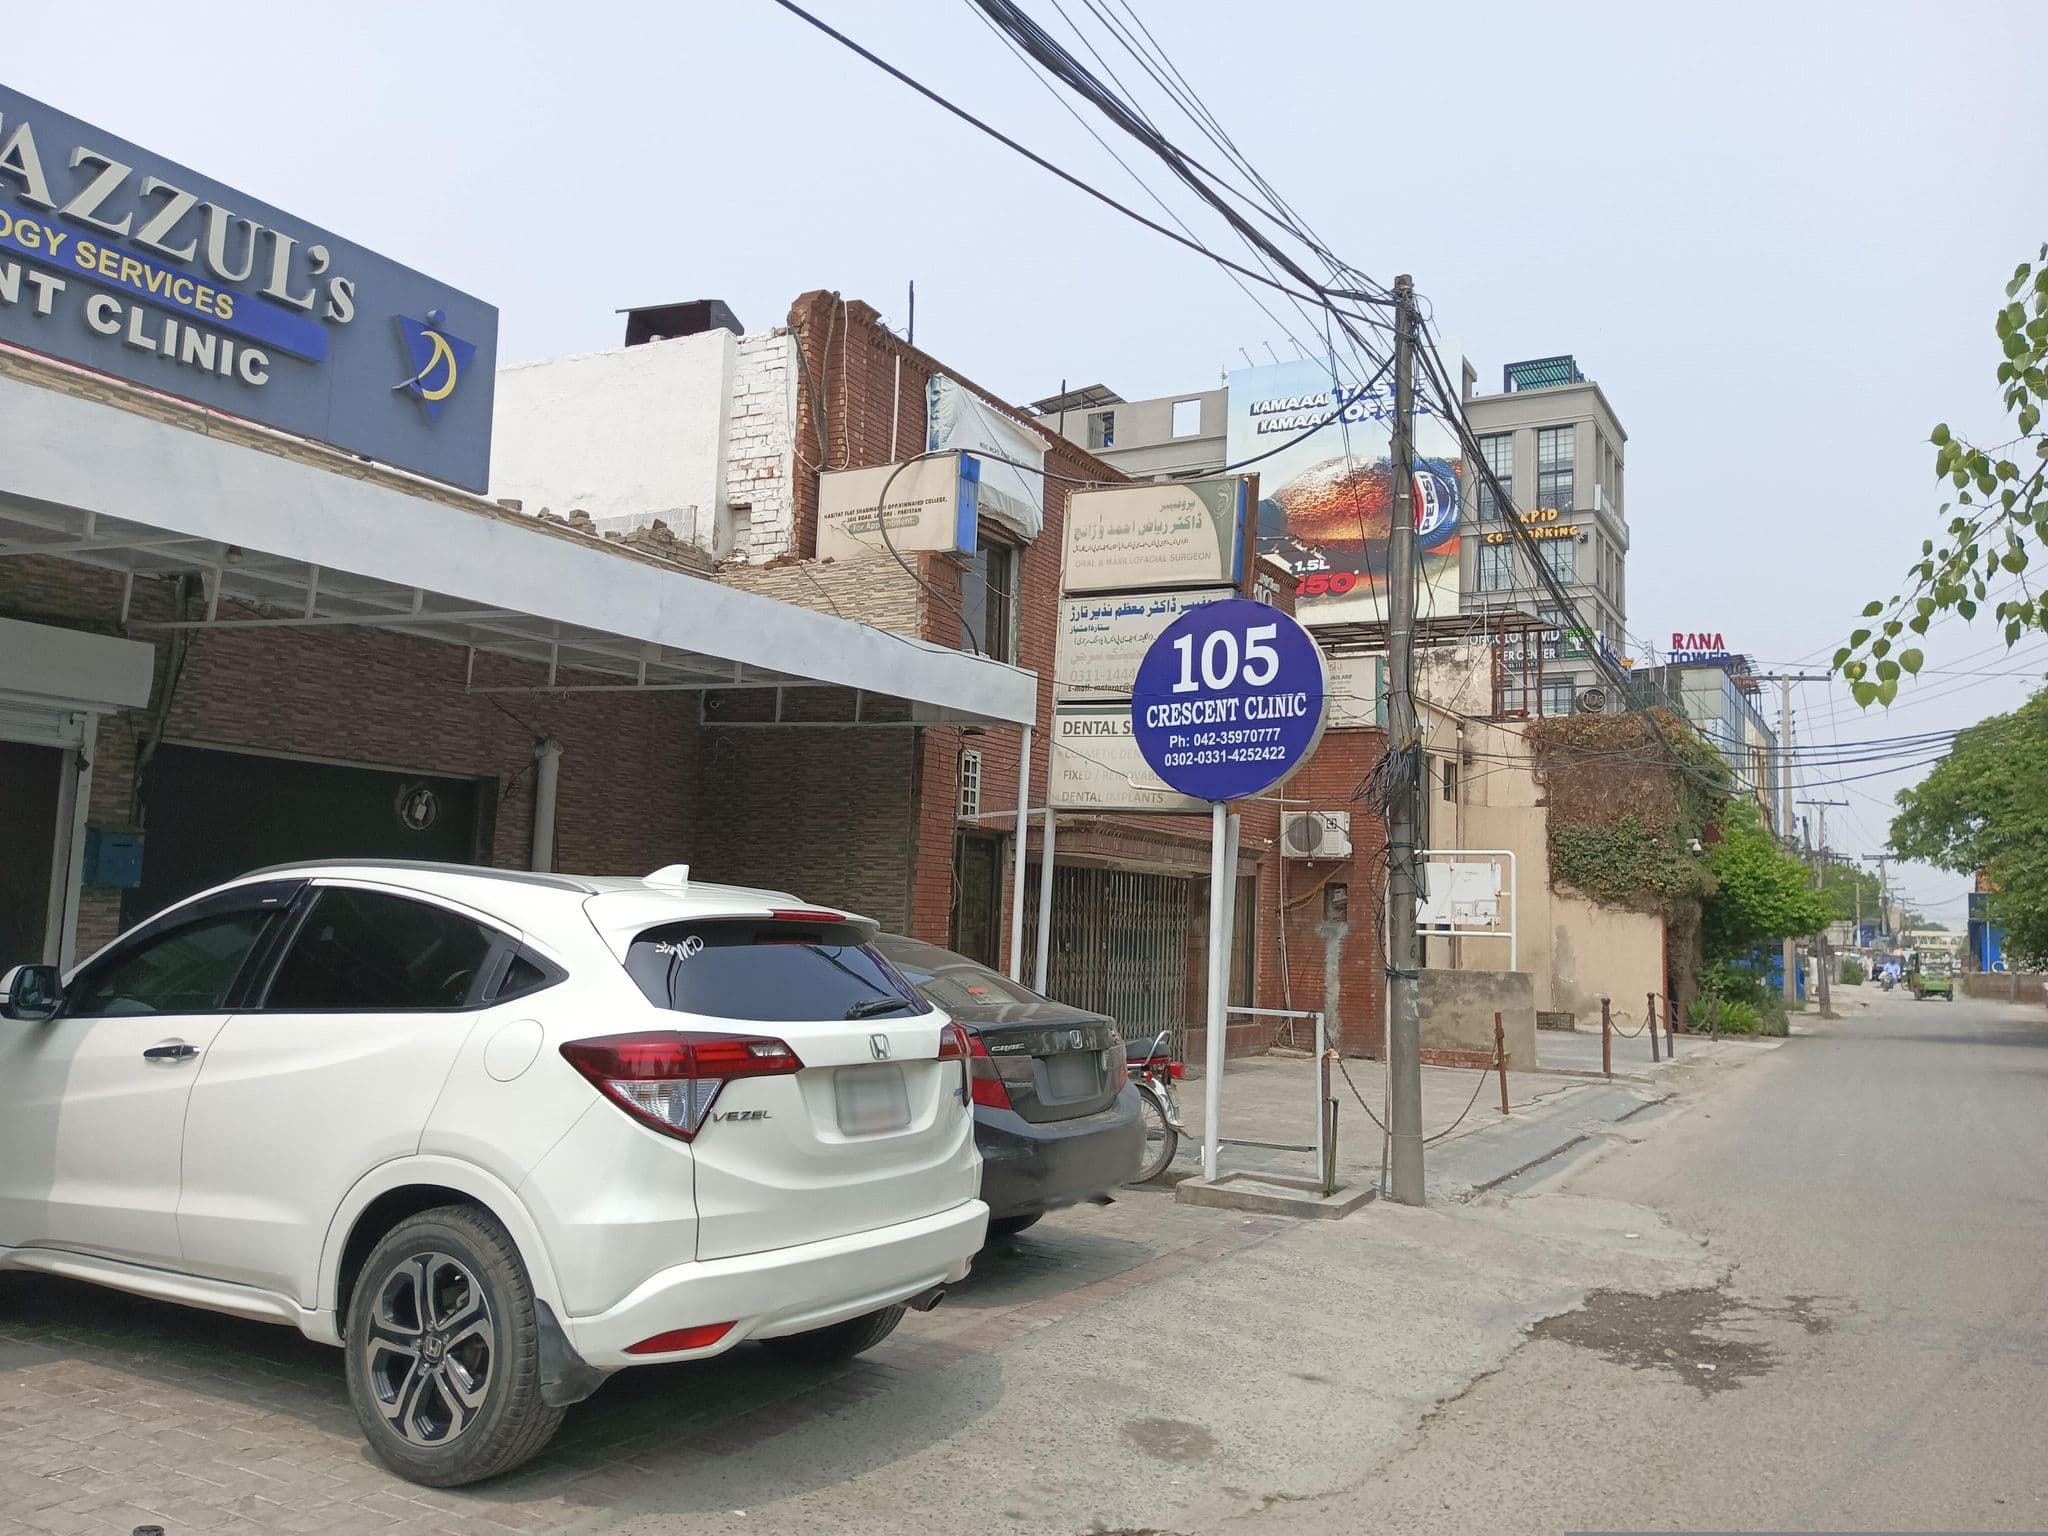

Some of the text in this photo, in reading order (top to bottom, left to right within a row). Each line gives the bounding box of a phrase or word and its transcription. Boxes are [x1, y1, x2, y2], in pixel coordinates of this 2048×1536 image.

[0, 112, 355, 323] AZZUL's
[75, 240, 234, 320] SERVICES
[86, 293, 270, 386] CLINIC
[1421, 474, 1435, 531] PEPSI
[1169, 551, 1212, 562] SURGEON
[1294, 559, 1331, 572] 1.5L
[1114, 602, 1145, 620] معظم
[1146, 597, 1177, 617] ڈاکٹر
[1672, 633, 1725, 650] RANA
[1172, 623, 1280, 693] 105
[1146, 697, 1240, 728] CRESCENT
[1244, 692, 1307, 721] CLINIC
[1062, 720, 1133, 735] DENTAL S
[1169, 728, 1281, 748] Ph: 042-35970777
[1164, 746, 1286, 767] 0302-0331-4252422
[1062, 791, 1163, 804] DENTAL IMPLANTS
[712, 1109, 773, 1123] VEZEL
